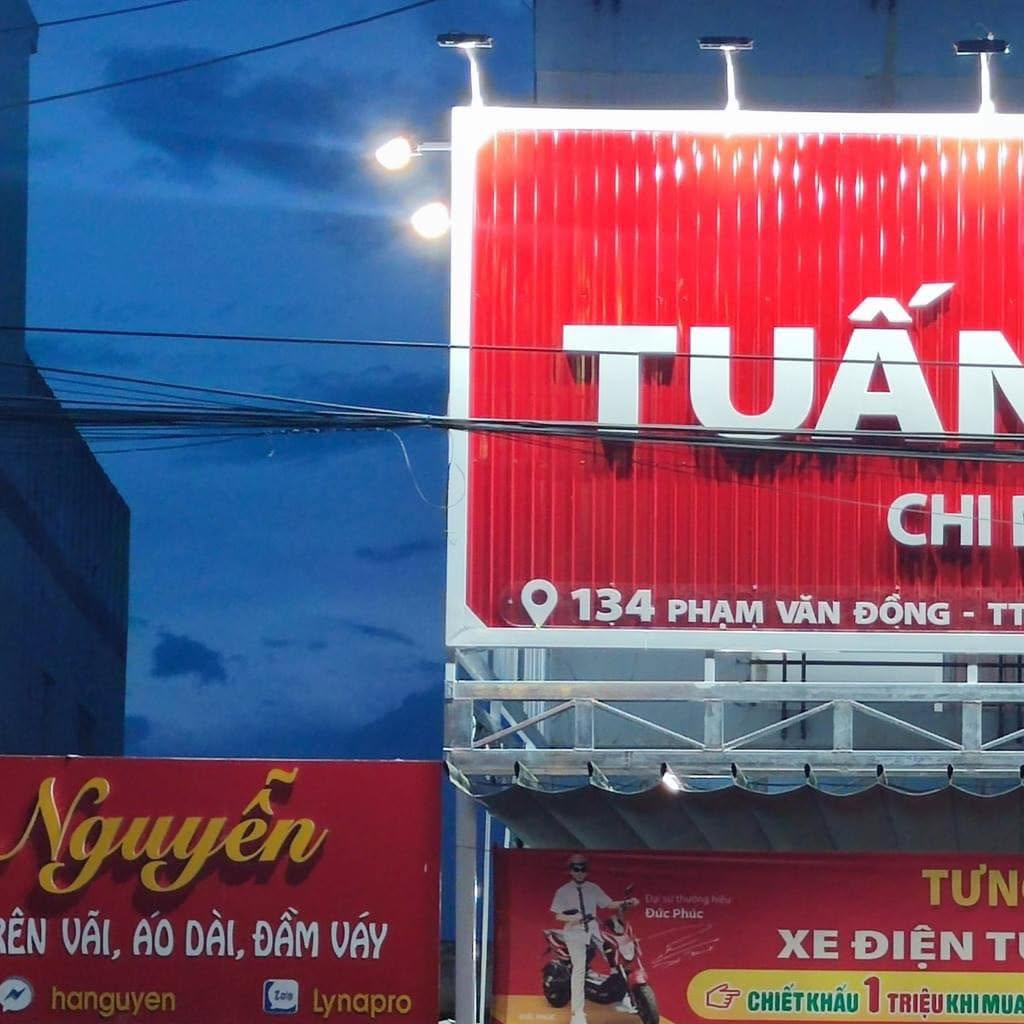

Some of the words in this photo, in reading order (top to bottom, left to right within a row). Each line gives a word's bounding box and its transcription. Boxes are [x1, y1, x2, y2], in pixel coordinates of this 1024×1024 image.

[887, 493, 991, 548] CHI
[571, 588, 655, 623] 134
[776, 594, 840, 625] VĂN
[854, 593, 950, 626] ĐỒNG
[0, 767, 329, 894] Nguyễn
[186, 910, 244, 961] DÀI,
[252, 907, 319, 958] ĐẦM
[331, 912, 388, 959] VÁY
[645, 907, 670, 919] Đức
[672, 907, 704, 919] Phúc
[777, 928, 839, 960] XE
[851, 924, 973, 970] ĐIỆN
[52, 986, 176, 1018] hanguyen
[313, 988, 412, 1018] Lynapro
[749, 982, 804, 1013] CHIẾT
[806, 983, 859, 1013] KHẤU
[864, 976, 880, 1014] 1
[887, 987, 943, 1019] TRIỆU
[946, 993, 979, 1014] KHI
